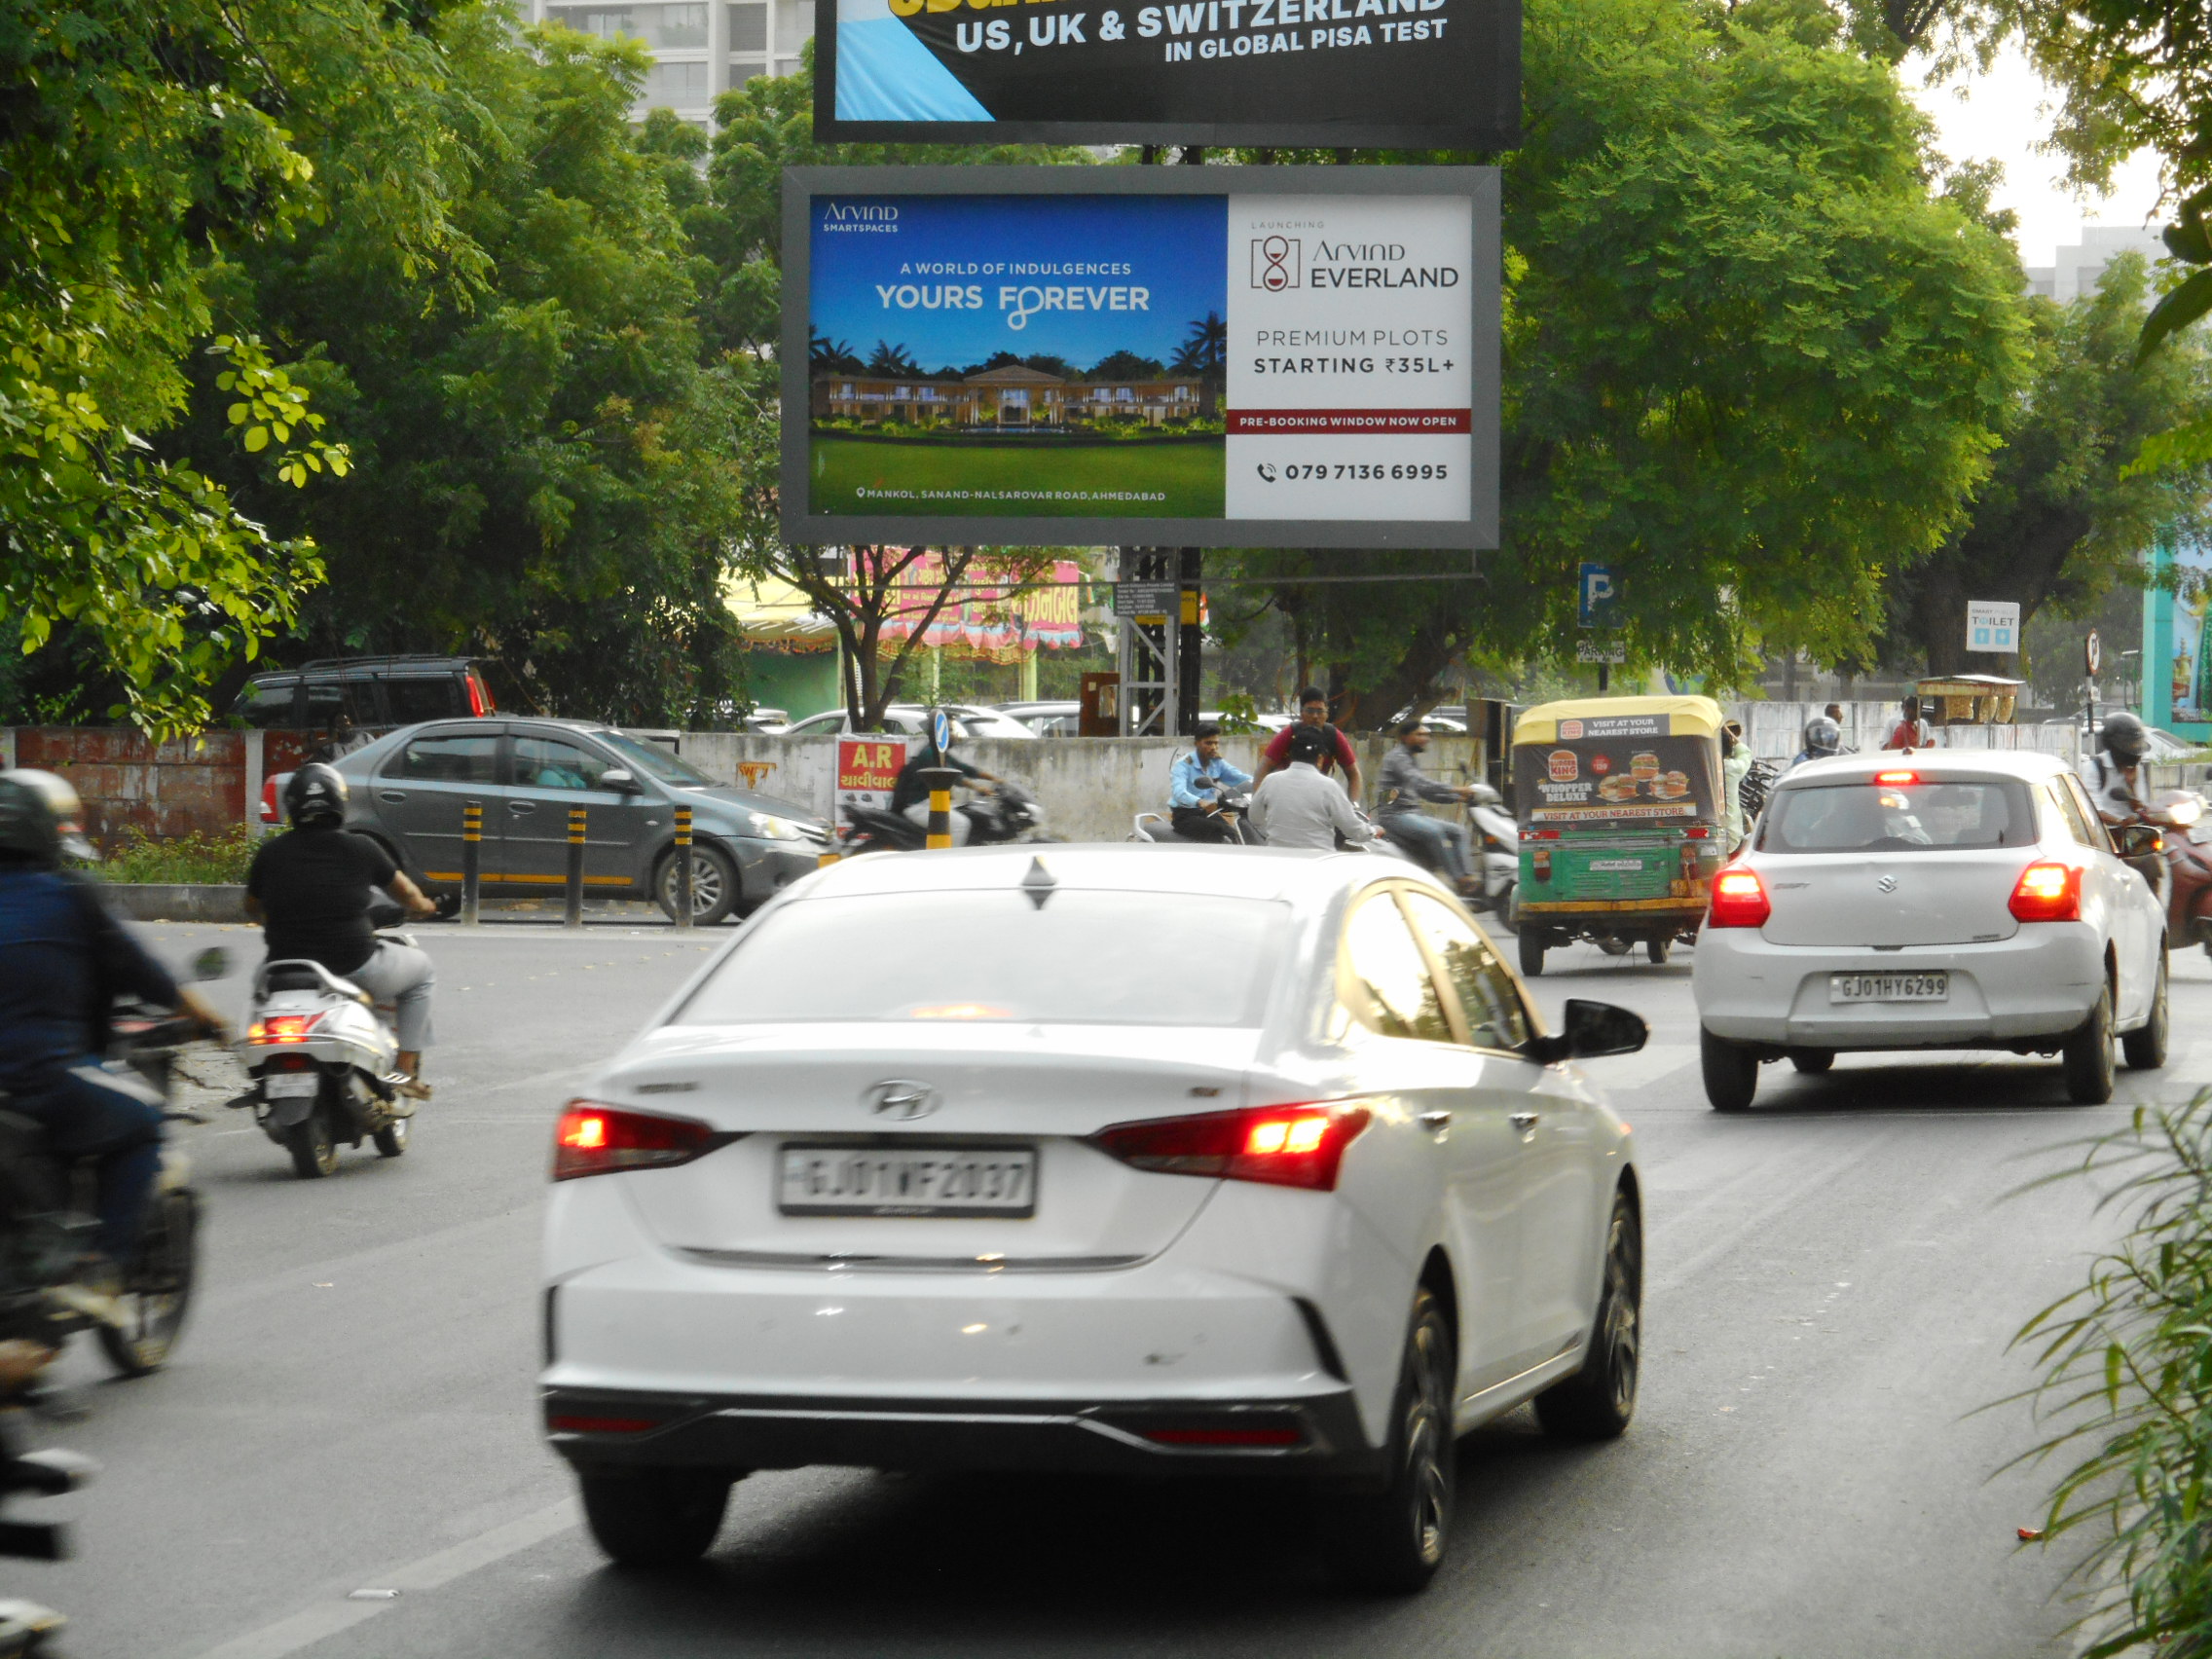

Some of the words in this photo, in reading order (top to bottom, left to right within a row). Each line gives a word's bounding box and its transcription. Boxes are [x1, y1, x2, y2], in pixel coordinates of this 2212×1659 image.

[1099, 11, 1125, 41] &
[1165, 42, 1193, 61] IN
[1199, 32, 1304, 58] GLOBAL
[1311, 26, 1372, 49] PISA
[1380, 18, 1448, 42] TEST
[824, 224, 899, 233] SMARTSPACES
[901, 263, 911, 275] A
[916, 263, 978, 275] WORLD
[982, 263, 1005, 275] OF
[1010, 263, 1131, 275] INDULGENCES
[1311, 268, 1458, 287] EVERLAND
[876, 285, 983, 309] YOURS
[1000, 286, 1150, 330] FOREVER
[1257, 331, 1366, 346] PREMIUM
[1374, 330, 1448, 345] PLOTS
[1254, 358, 1374, 373] STARTING
[1385, 357, 1455, 372] ₹35L+
[1240, 417, 1327, 426] PRE-BOOKING
[1331, 417, 1386, 426] WINDOW
[1389, 417, 1419, 426] NOW
[1422, 417, 1456, 425] OPEN
[1285, 465, 1328, 479] 079
[1334, 465, 1384, 479] 7136
[1391, 464, 1448, 479] 6995
[921, 490, 1052, 499] SANAND-NALSAROVAR
[1587, 573, 1614, 611] P
[1972, 616, 2014, 626] TOILET
[1592, 719, 1614, 728] VISIT
[1629, 719, 1654, 727] YOUR
[1588, 728, 1628, 737] NEAREST
[1629, 726, 1658, 735] STORE
[852, 744, 893, 768] A.R
[1551, 766, 1576, 775] KING
[1539, 783, 1592, 793] WHOPPER
[1546, 792, 1587, 802] DELUXE
[1544, 812, 1567, 821] VISIT
[1569, 811, 1581, 820] AT
[1583, 810, 1607, 820] YOUR
[1609, 808, 1652, 818] NEAREST
[1654, 807, 1684, 816] STORE
[1842, 978, 1945, 997] GJ01HY6299
